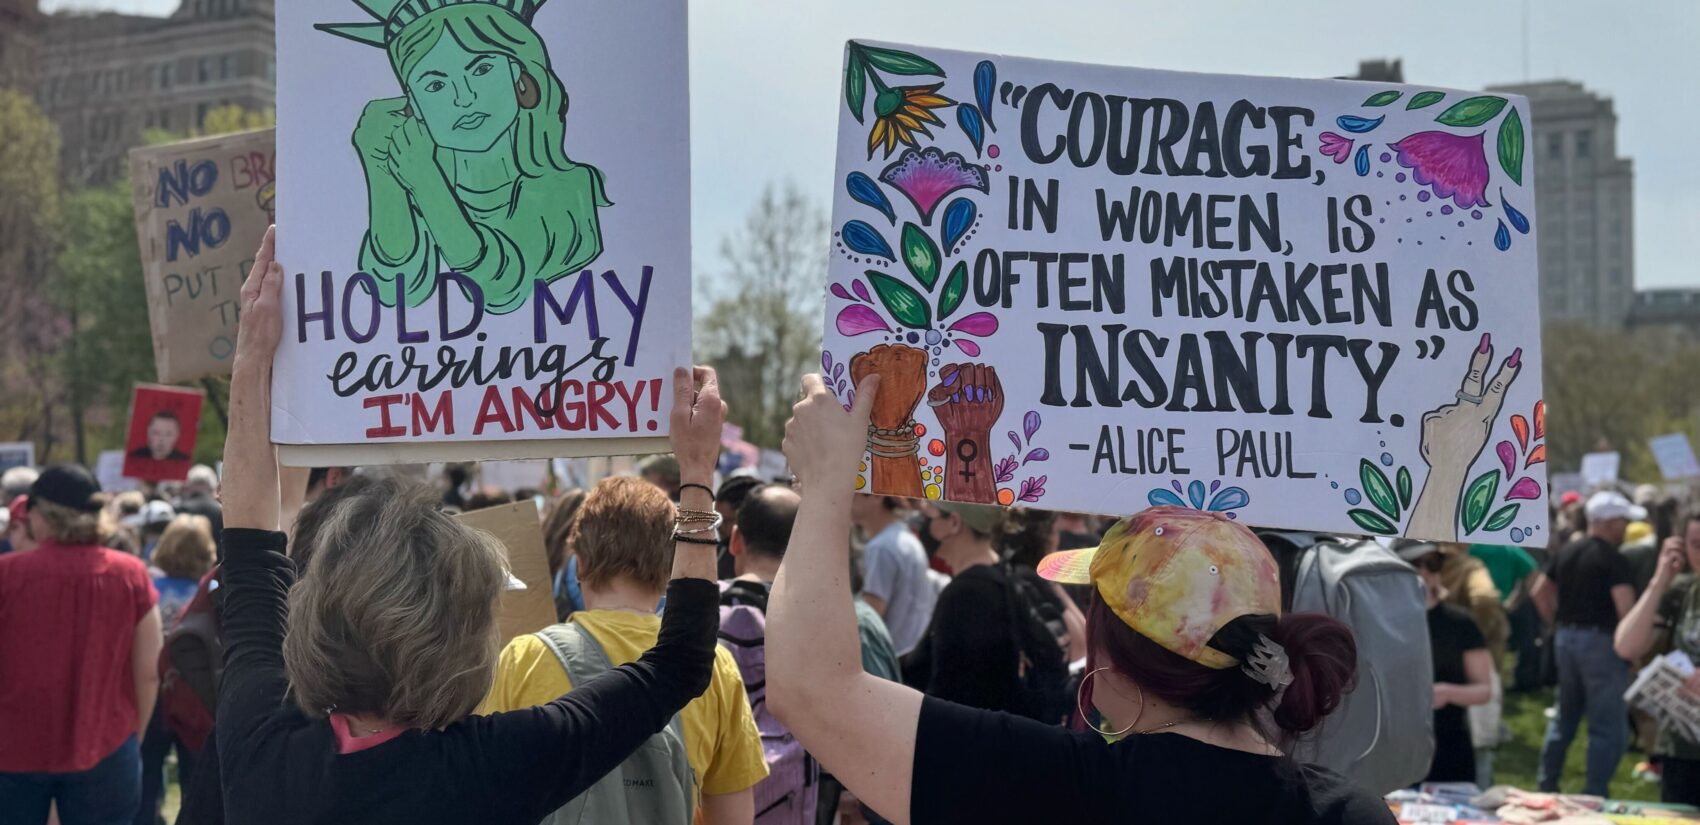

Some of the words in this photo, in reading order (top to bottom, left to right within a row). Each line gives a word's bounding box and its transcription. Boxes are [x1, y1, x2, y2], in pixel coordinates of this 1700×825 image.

[1000, 82, 1325, 186] “COURAGE,
[154, 158, 218, 208] NO
[1007, 175, 1059, 233] IN
[1095, 185, 1294, 256] WOMEN,
[1326, 194, 1376, 254] IS
[166, 207, 231, 262] NO
[163, 265, 222, 306] PUT
[295, 270, 484, 343] HOLD
[533, 265, 654, 367] MY
[973, 248, 1125, 314] OFTEN
[1150, 256, 1393, 327] MISTAKEN
[1415, 269, 1479, 332] AS
[326, 332, 619, 417] earrings
[362, 390, 455, 438] I'M
[472, 378, 663, 436] ANGRY!
[1216, 428, 1317, 479] PAUL
